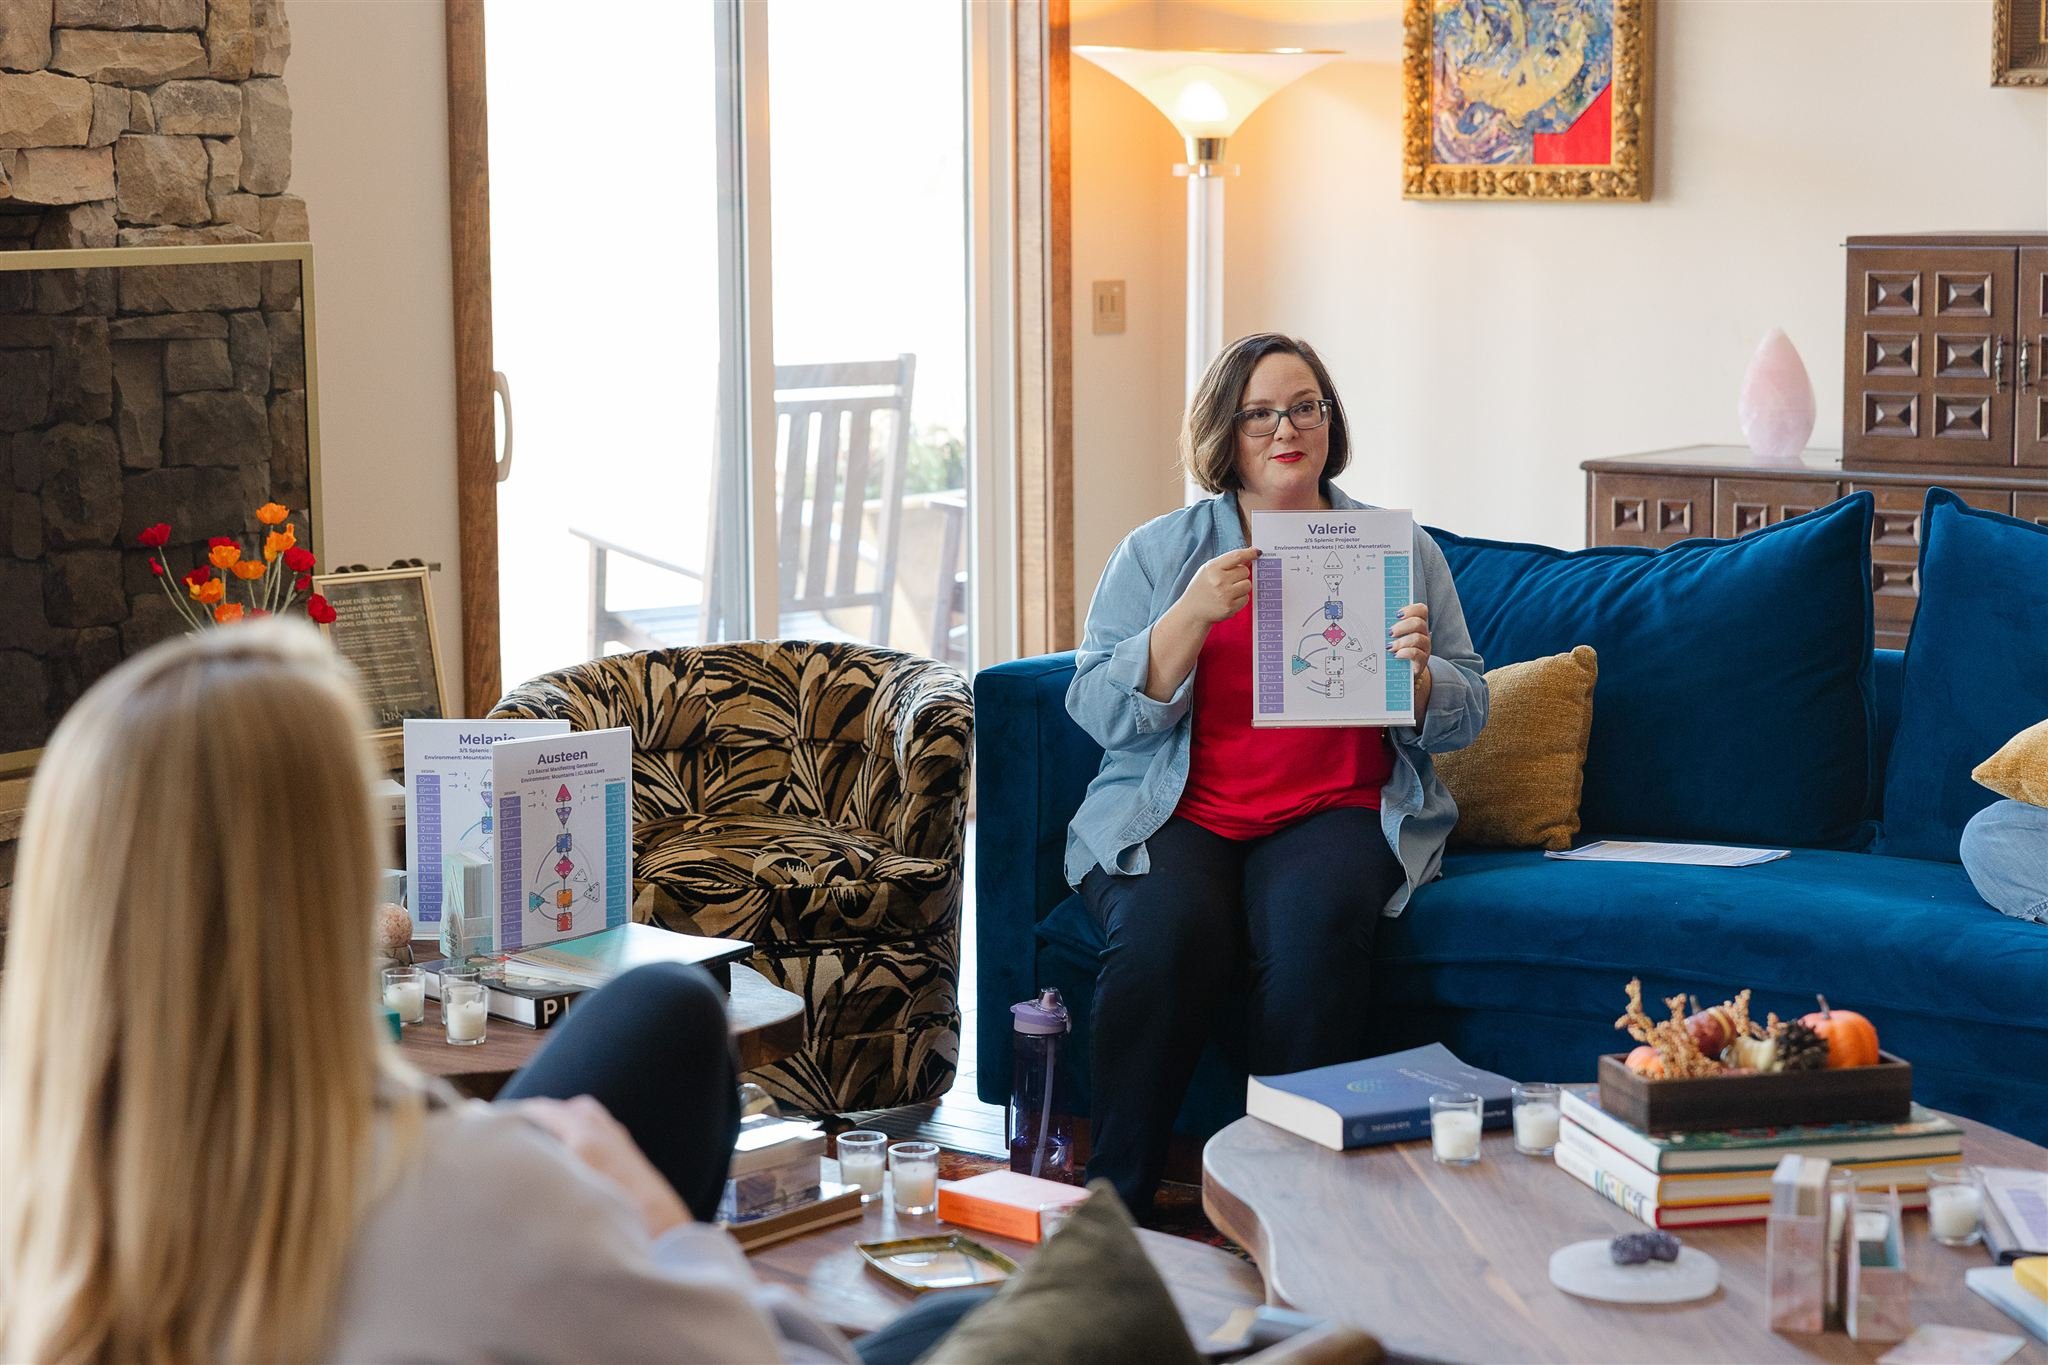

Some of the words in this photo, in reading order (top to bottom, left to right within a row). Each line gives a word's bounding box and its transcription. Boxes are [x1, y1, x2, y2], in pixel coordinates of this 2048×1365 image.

[1308, 522, 1356, 534] Valerie
[537, 750, 588, 765] Austeen
[550, 764, 576, 773] Manifesting
